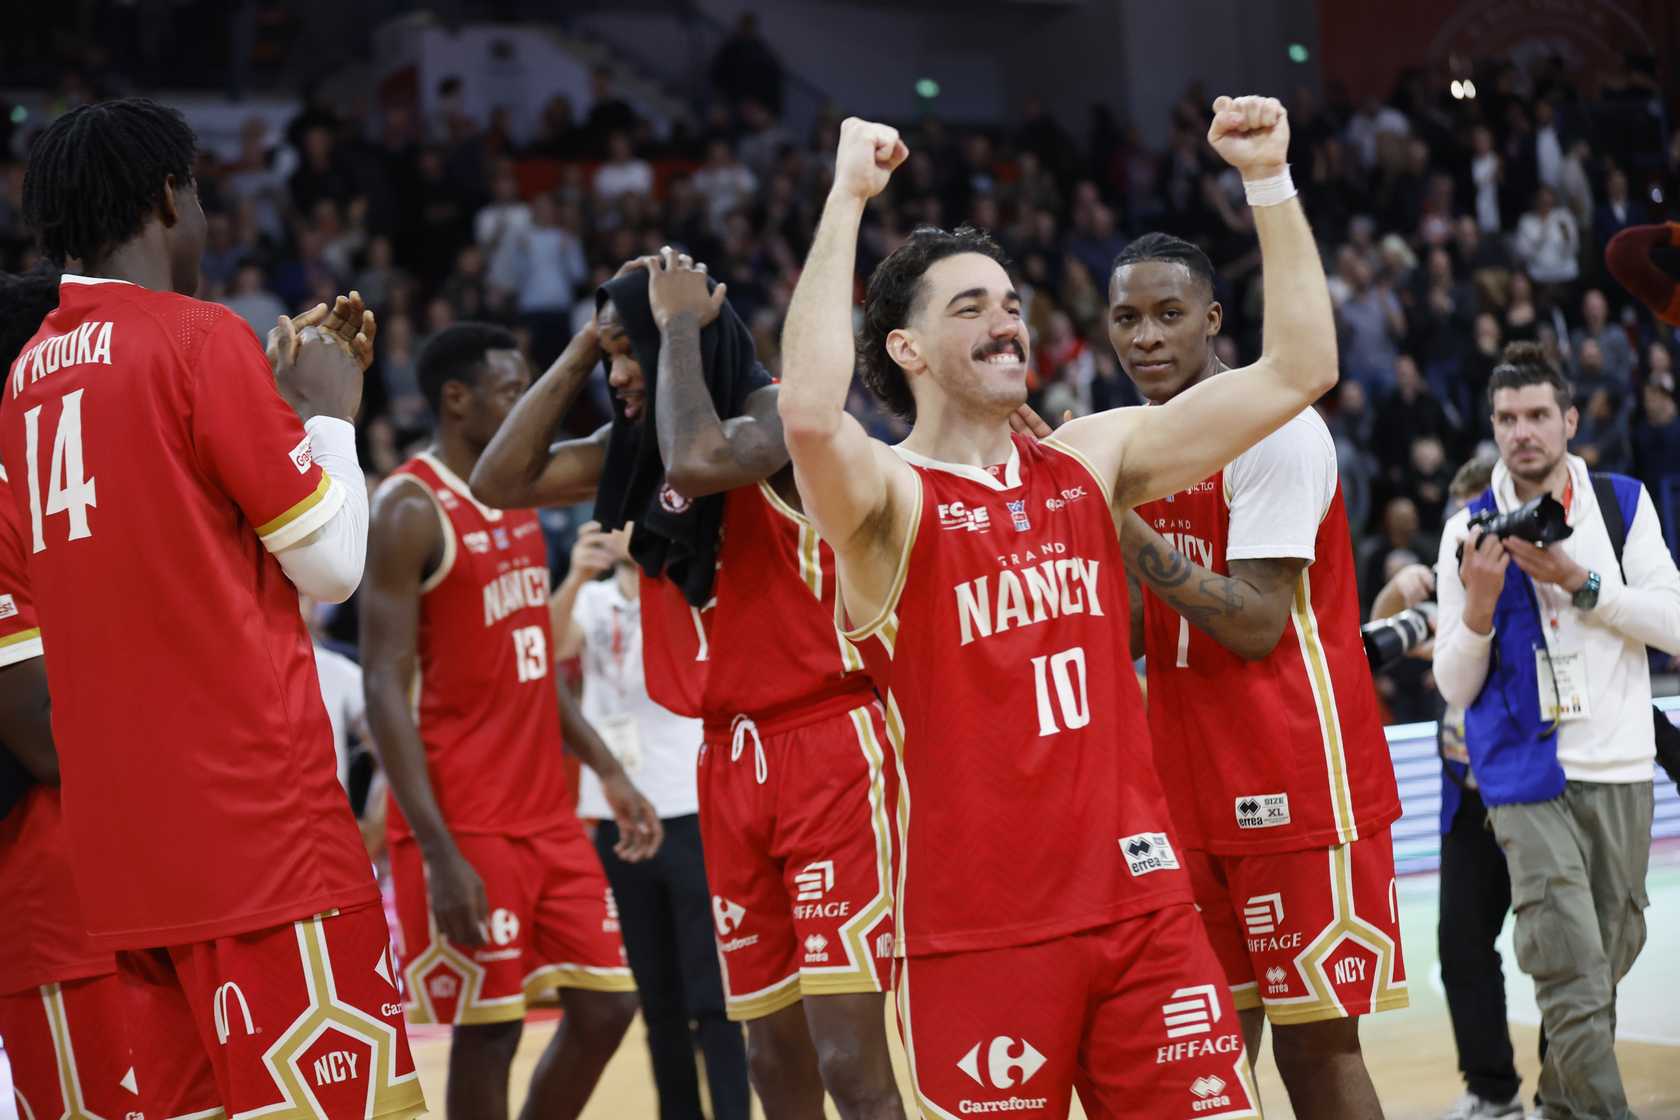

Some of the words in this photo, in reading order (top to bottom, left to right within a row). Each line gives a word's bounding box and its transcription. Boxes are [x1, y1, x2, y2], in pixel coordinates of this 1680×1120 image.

[12, 321, 114, 401] N'KOUKA
[23, 387, 97, 554] 14
[954, 557, 1105, 646] NANCY
[512, 625, 548, 683] 13
[1030, 646, 1091, 737] 10
[1238, 815, 1263, 827] errea
[1267, 808, 1284, 818] XL
[1131, 857, 1162, 873] errea
[1334, 957, 1366, 985] NCY
[1156, 1034, 1240, 1064] EIFFAGE
[313, 1050, 359, 1086] NCY
[959, 1096, 1047, 1114] Carrefour
[1192, 1095, 1231, 1112] errea
